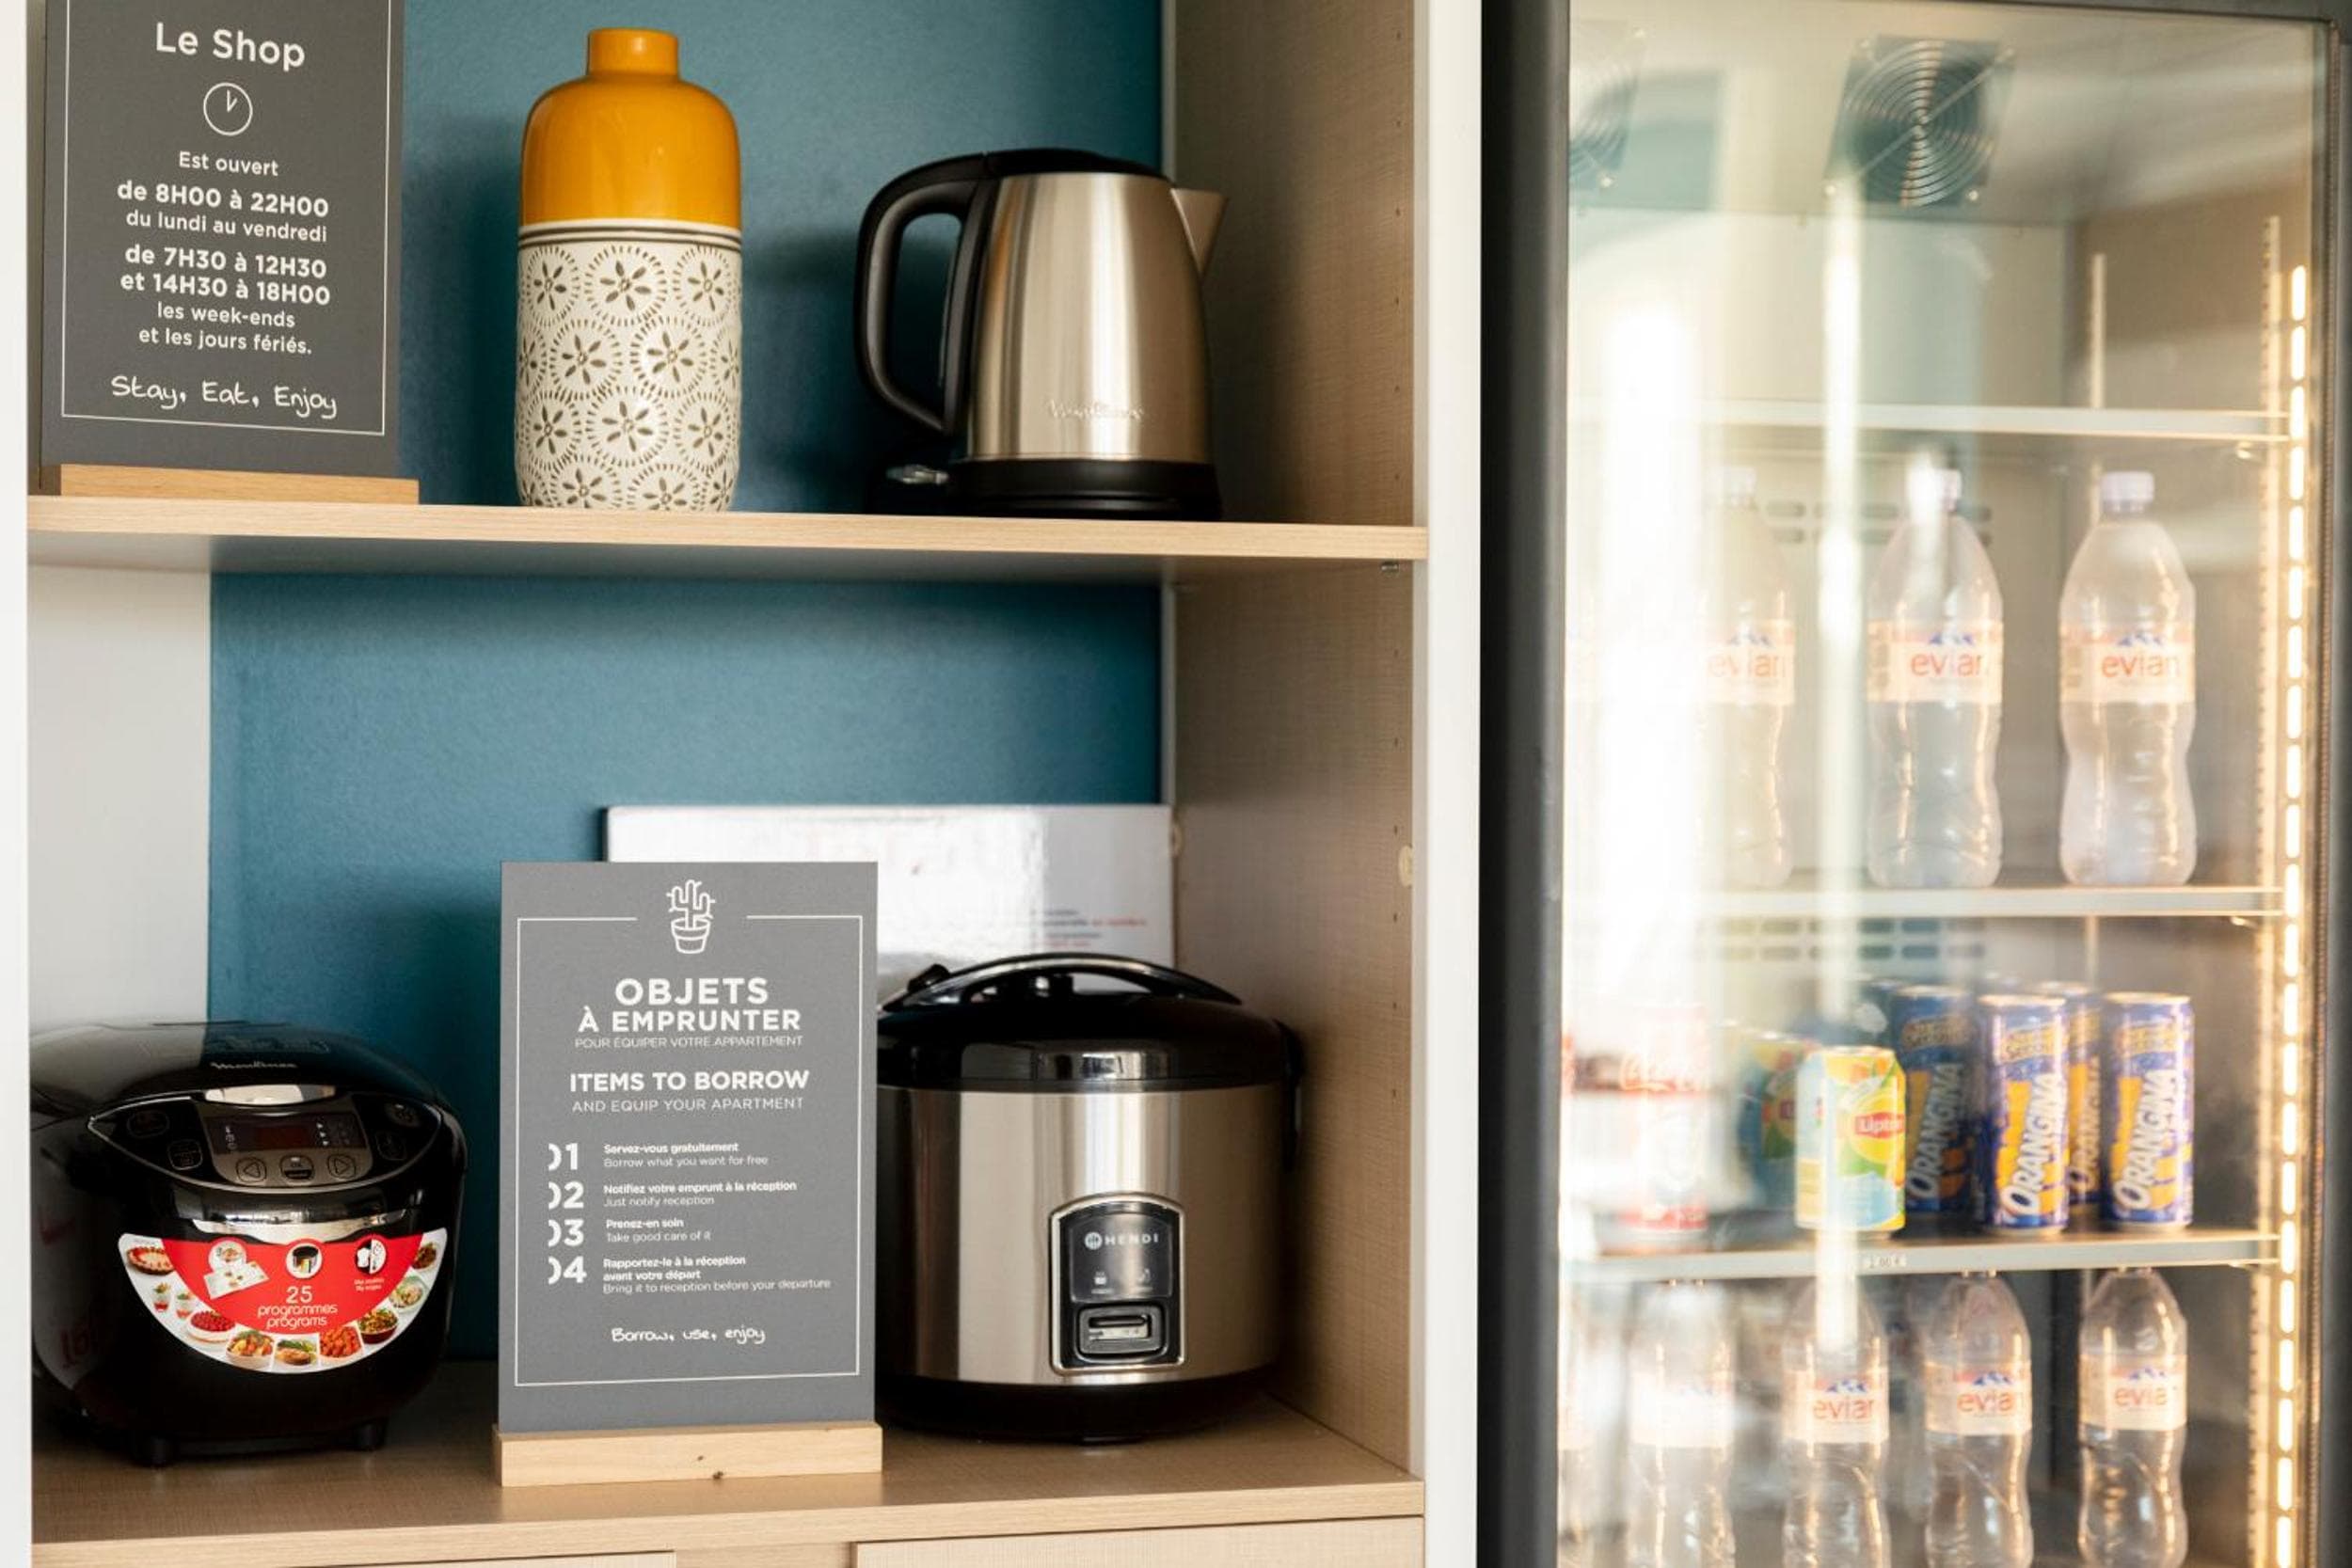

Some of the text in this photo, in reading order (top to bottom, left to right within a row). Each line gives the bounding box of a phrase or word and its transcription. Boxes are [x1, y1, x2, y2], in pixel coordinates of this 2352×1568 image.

[156, 22, 306, 71] Le Shop
[179, 150, 278, 177] Est ouvert
[117, 180, 329, 218] de 8H00 à 22H00
[126, 209, 327, 243] du lundi au vendredi
[124, 243, 327, 279] de 7H30 à 12H30
[119, 273, 330, 306] et 14H30 à 18H00
[157, 300, 295, 328] les week-ends
[138, 326, 312, 355] et les jours fériés.
[110, 374, 338, 420] Stay, Eat, Enjoy
[614, 976, 770, 1006] OBJETS
[578, 1006, 802, 1033] À EMPRUNTER
[574, 1037, 611, 1049] POUR
[670, 1036, 712, 1048] VOTRE
[713, 1035, 803, 1048] APPARTEMENT
[570, 1069, 810, 1093] ITEMS TO BORROW
[572, 1096, 803, 1114] AND EQUIP YOUR APARTMENT
[603, 1142, 739, 1155] Servez-vous gratuitement
[603, 1155, 769, 1169] Borrow what you want for free
[603, 1180, 798, 1196] Notifiez votre emprunt à la réception
[603, 1195, 715, 1208] Just notify reception
[605, 1217, 685, 1229] Prenez-en soin
[607, 1232, 629, 1243] Take
[632, 1232, 661, 1244] good
[663, 1232, 688, 1242] care
[690, 1230, 702, 1241] of
[1104, 1232, 1160, 1246] HENDI
[603, 1255, 747, 1269] Rapportez-le à la réception
[603, 1269, 702, 1282] avant votre départ
[285, 1285, 313, 1304] 25
[603, 1278, 832, 1296] Bring it to reception before your departure
[257, 1304, 339, 1319] programmes
[266, 1316, 327, 1330] programs
[611, 1324, 767, 1345] Borrow, use, enjoy
